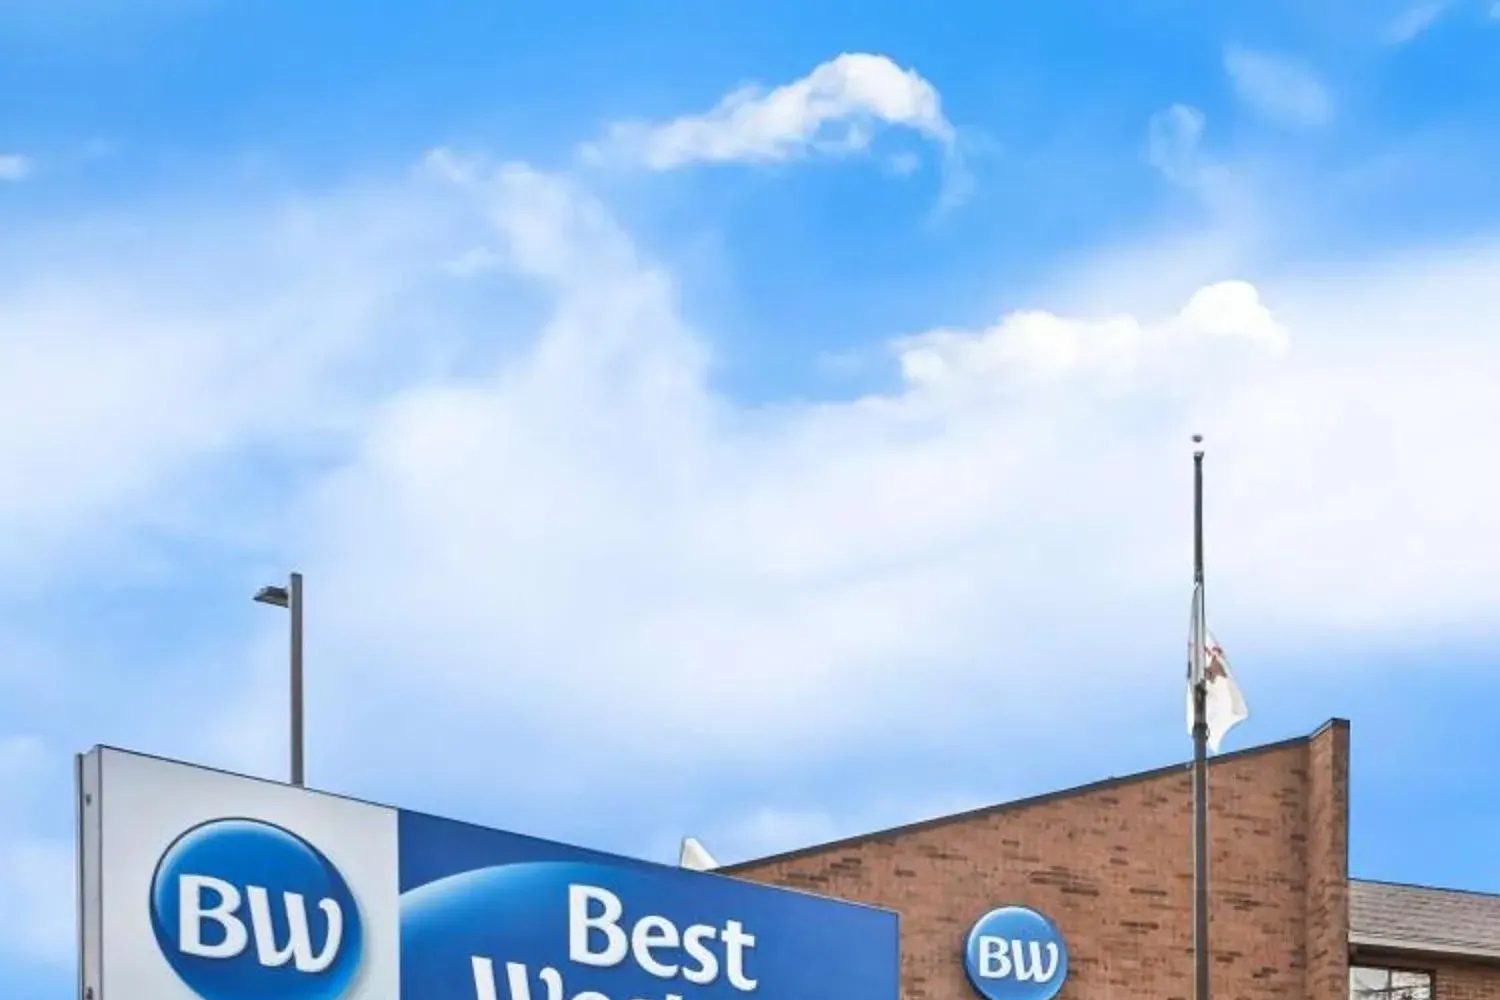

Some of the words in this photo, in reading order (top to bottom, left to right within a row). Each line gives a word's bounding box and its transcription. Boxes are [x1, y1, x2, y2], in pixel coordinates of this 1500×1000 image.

[179, 874, 342, 972] BW
[569, 884, 757, 991] Best
[979, 935, 1059, 983] BW
